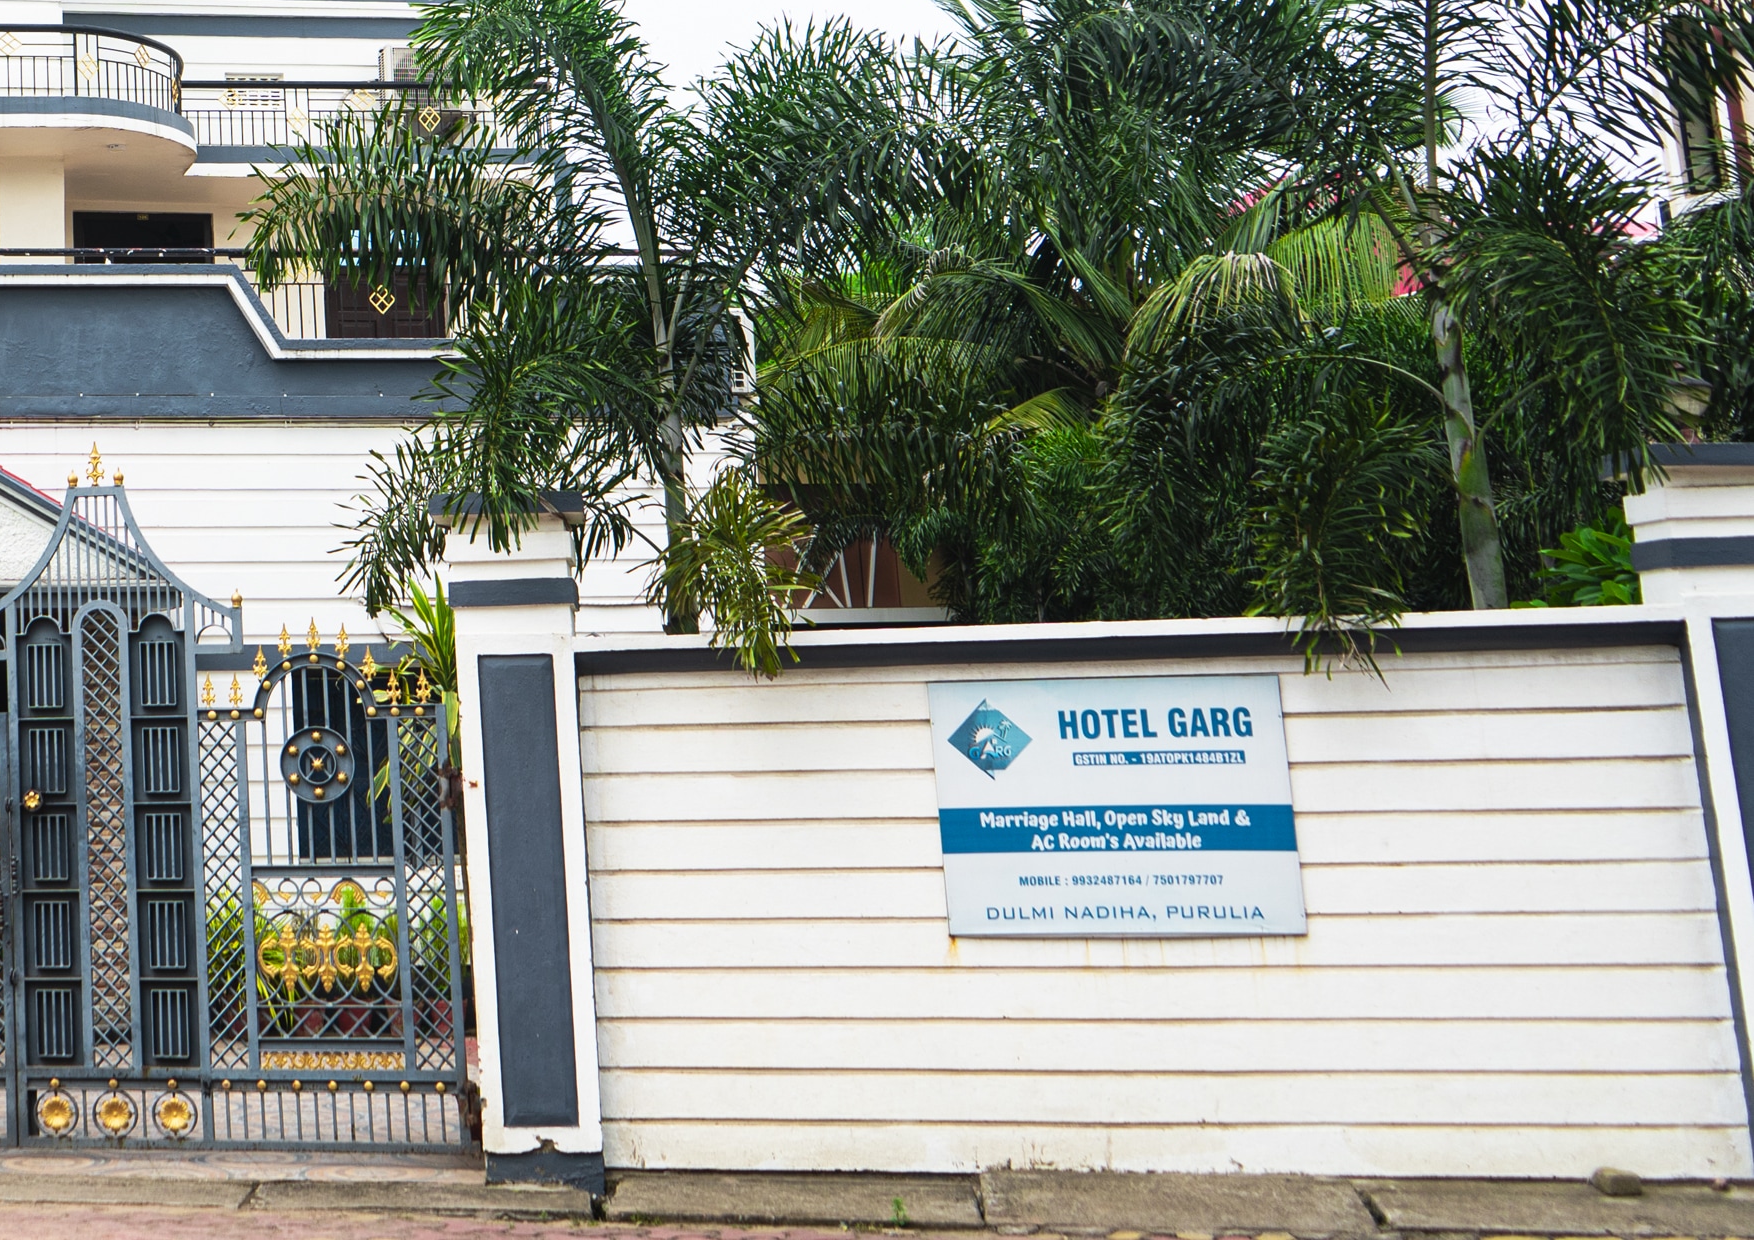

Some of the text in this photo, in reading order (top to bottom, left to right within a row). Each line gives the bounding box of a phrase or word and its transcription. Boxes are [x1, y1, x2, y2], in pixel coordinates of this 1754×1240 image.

[1057, 706, 1253, 740] HOTEL GARG
[968, 740, 1012, 759] GARG
[1074, 753, 1107, 765] GSTIN
[1110, 753, 1129, 764] NO.
[1140, 751, 1244, 764] 19ATOPK1484B1ZL
[979, 809, 1251, 830] Marriage Hall, Open Sky Land &
[1031, 832, 1202, 850] AC Room's Available
[1019, 876, 1061, 886] MOBILE
[1072, 875, 1142, 886] 9932487164
[1153, 875, 1224, 886] 7501797707
[986, 905, 1265, 922] DULMI NADIHA, PURULIA
